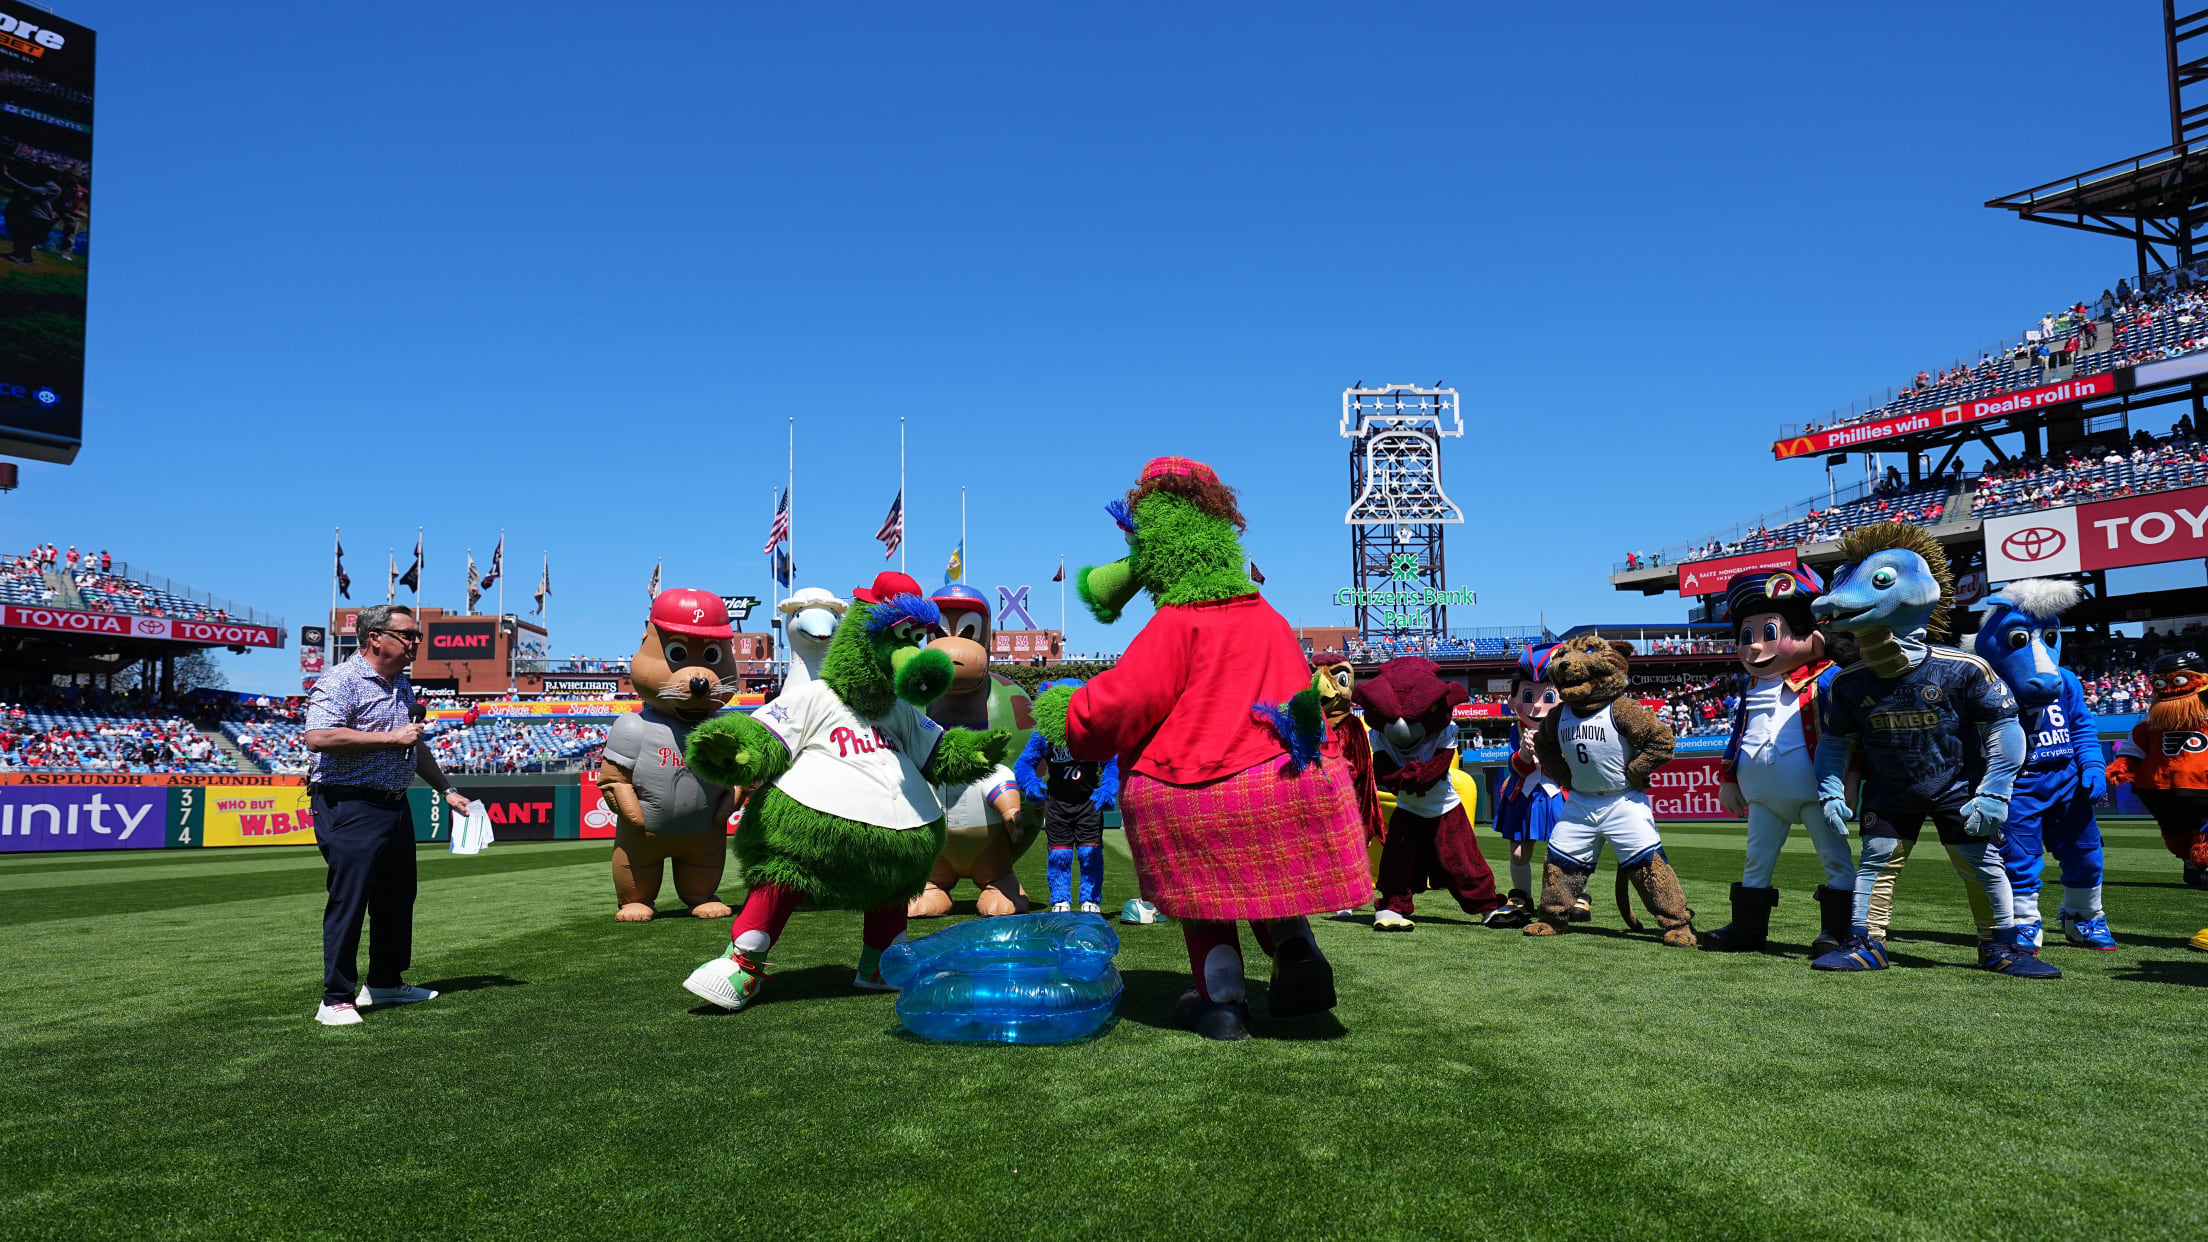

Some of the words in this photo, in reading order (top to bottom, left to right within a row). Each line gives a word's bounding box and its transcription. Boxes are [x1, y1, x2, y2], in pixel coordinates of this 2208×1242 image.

[1828, 422, 1894, 447] Phillies
[1895, 416, 1930, 433] win
[1974, 391, 2032, 418] Deals
[2035, 385, 2072, 406] roll
[2076, 380, 2095, 397] in
[2093, 505, 2208, 550] TOY
[1337, 587, 1419, 606] Citizens
[1423, 585, 1475, 606] Bank
[692, 608, 705, 624] P
[995, 586, 1040, 630] X
[15, 608, 122, 632] TOYOTA
[1383, 608, 1430, 628] Park
[181, 623, 271, 644] TOYOTA
[433, 634, 490, 648] GIANT
[997, 636, 1010, 647] 32
[1016, 635, 1029, 647] 34
[421, 688, 456, 696] Fanatics
[487, 703, 530, 717] Surfside
[567, 702, 610, 716] Surfside
[2026, 704, 2066, 731] 76
[1870, 712, 1939, 730] BIMBO
[1560, 725, 1607, 744] VILLANOVA
[2028, 728, 2070, 748] COATS
[1576, 742, 1589, 764] 6
[20, 774, 143, 785] ASPLUNDH
[166, 775, 273, 786] ASPLUNDH
[1063, 765, 1081, 780] 76
[216, 799, 247, 811] WHO
[250, 799, 275, 810] BUT
[1, 793, 153, 840] inity
